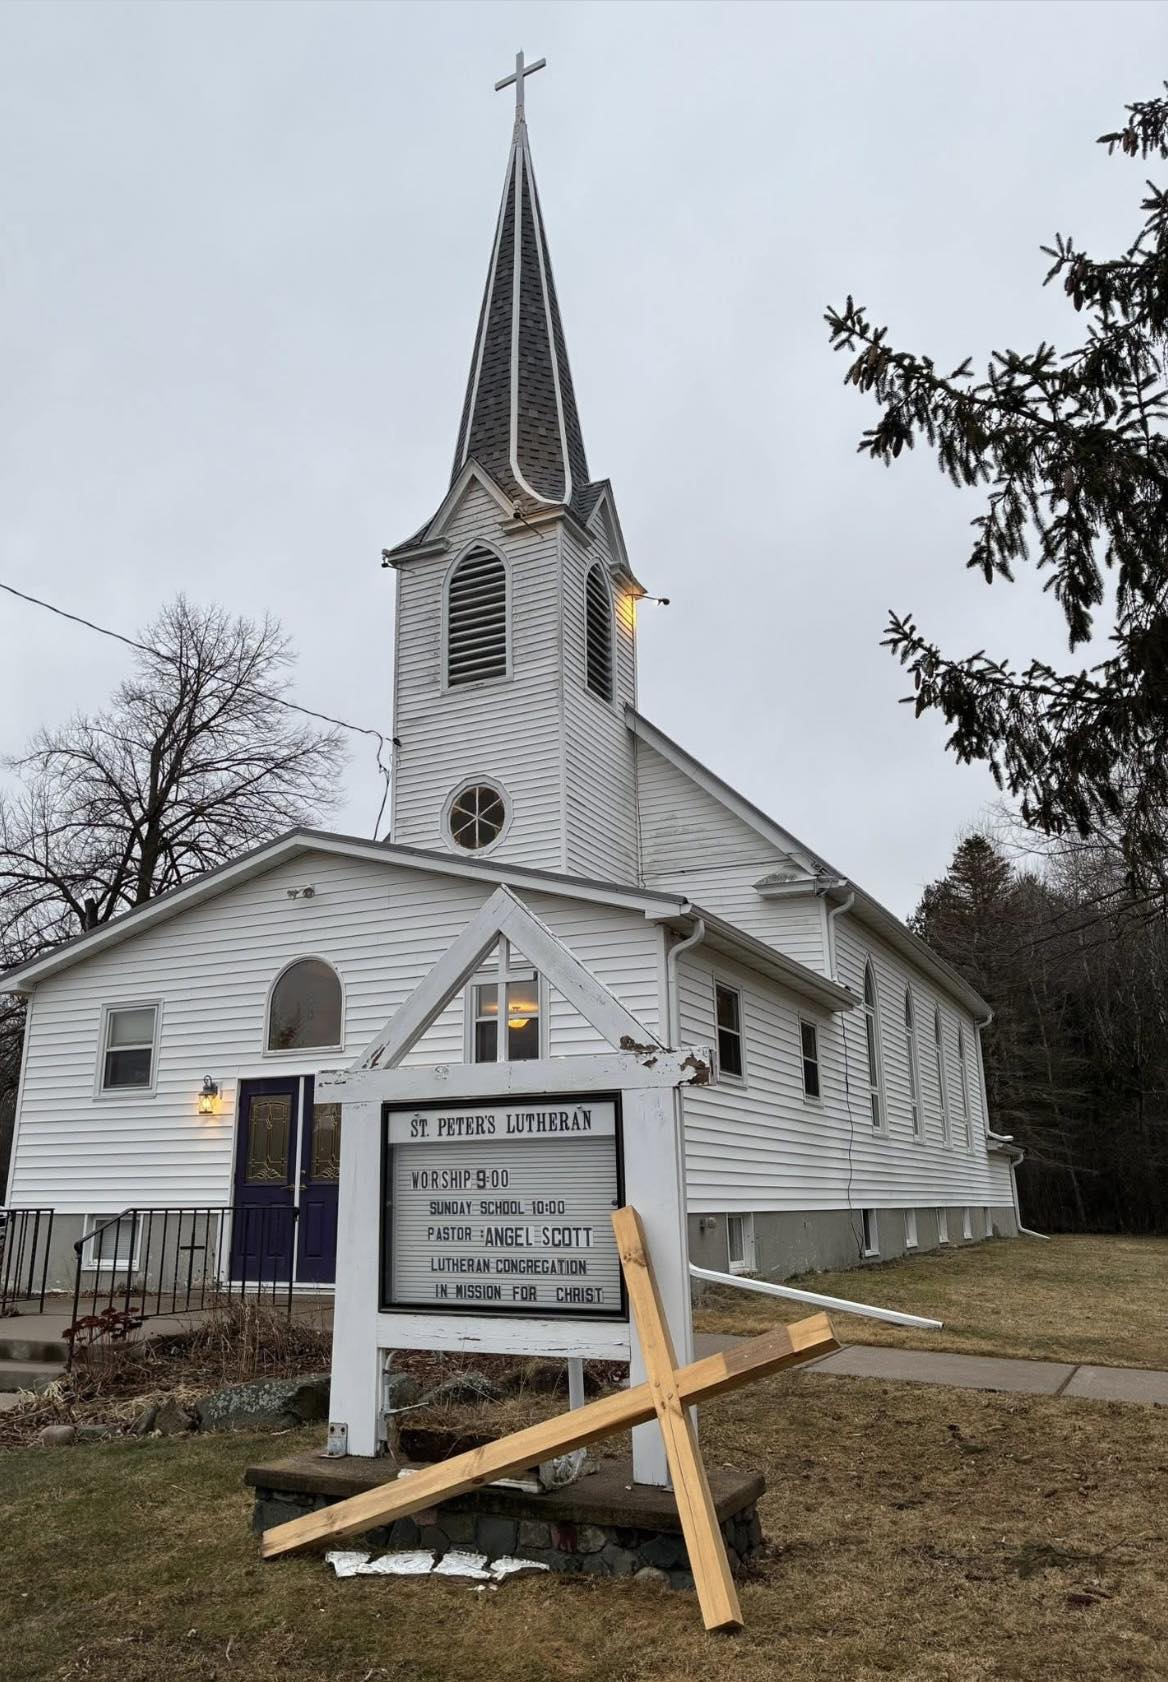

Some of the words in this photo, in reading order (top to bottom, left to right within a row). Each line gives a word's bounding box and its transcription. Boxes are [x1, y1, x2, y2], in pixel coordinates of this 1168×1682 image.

[411, 1118, 429, 1137] ST.
[437, 1115, 496, 1137] PETER'S
[506, 1110, 592, 1134] LUTHERAN
[411, 1170, 471, 1189] WORSHIP
[476, 1169, 509, 1189] 9:00
[430, 1201, 472, 1215] SUNDAY
[480, 1201, 525, 1215] SCHOOL
[532, 1200, 565, 1215] 10:00
[428, 1227, 472, 1241] PASTOR
[542, 1227, 593, 1247] SCOTT
[431, 1258, 490, 1273] LUTHERAN
[496, 1259, 587, 1275] CONGREGATION
[435, 1284, 447, 1298] IN
[456, 1284, 501, 1300] MISSION
[512, 1286, 537, 1301] FOR
[556, 1287, 603, 1303] CHRIST
